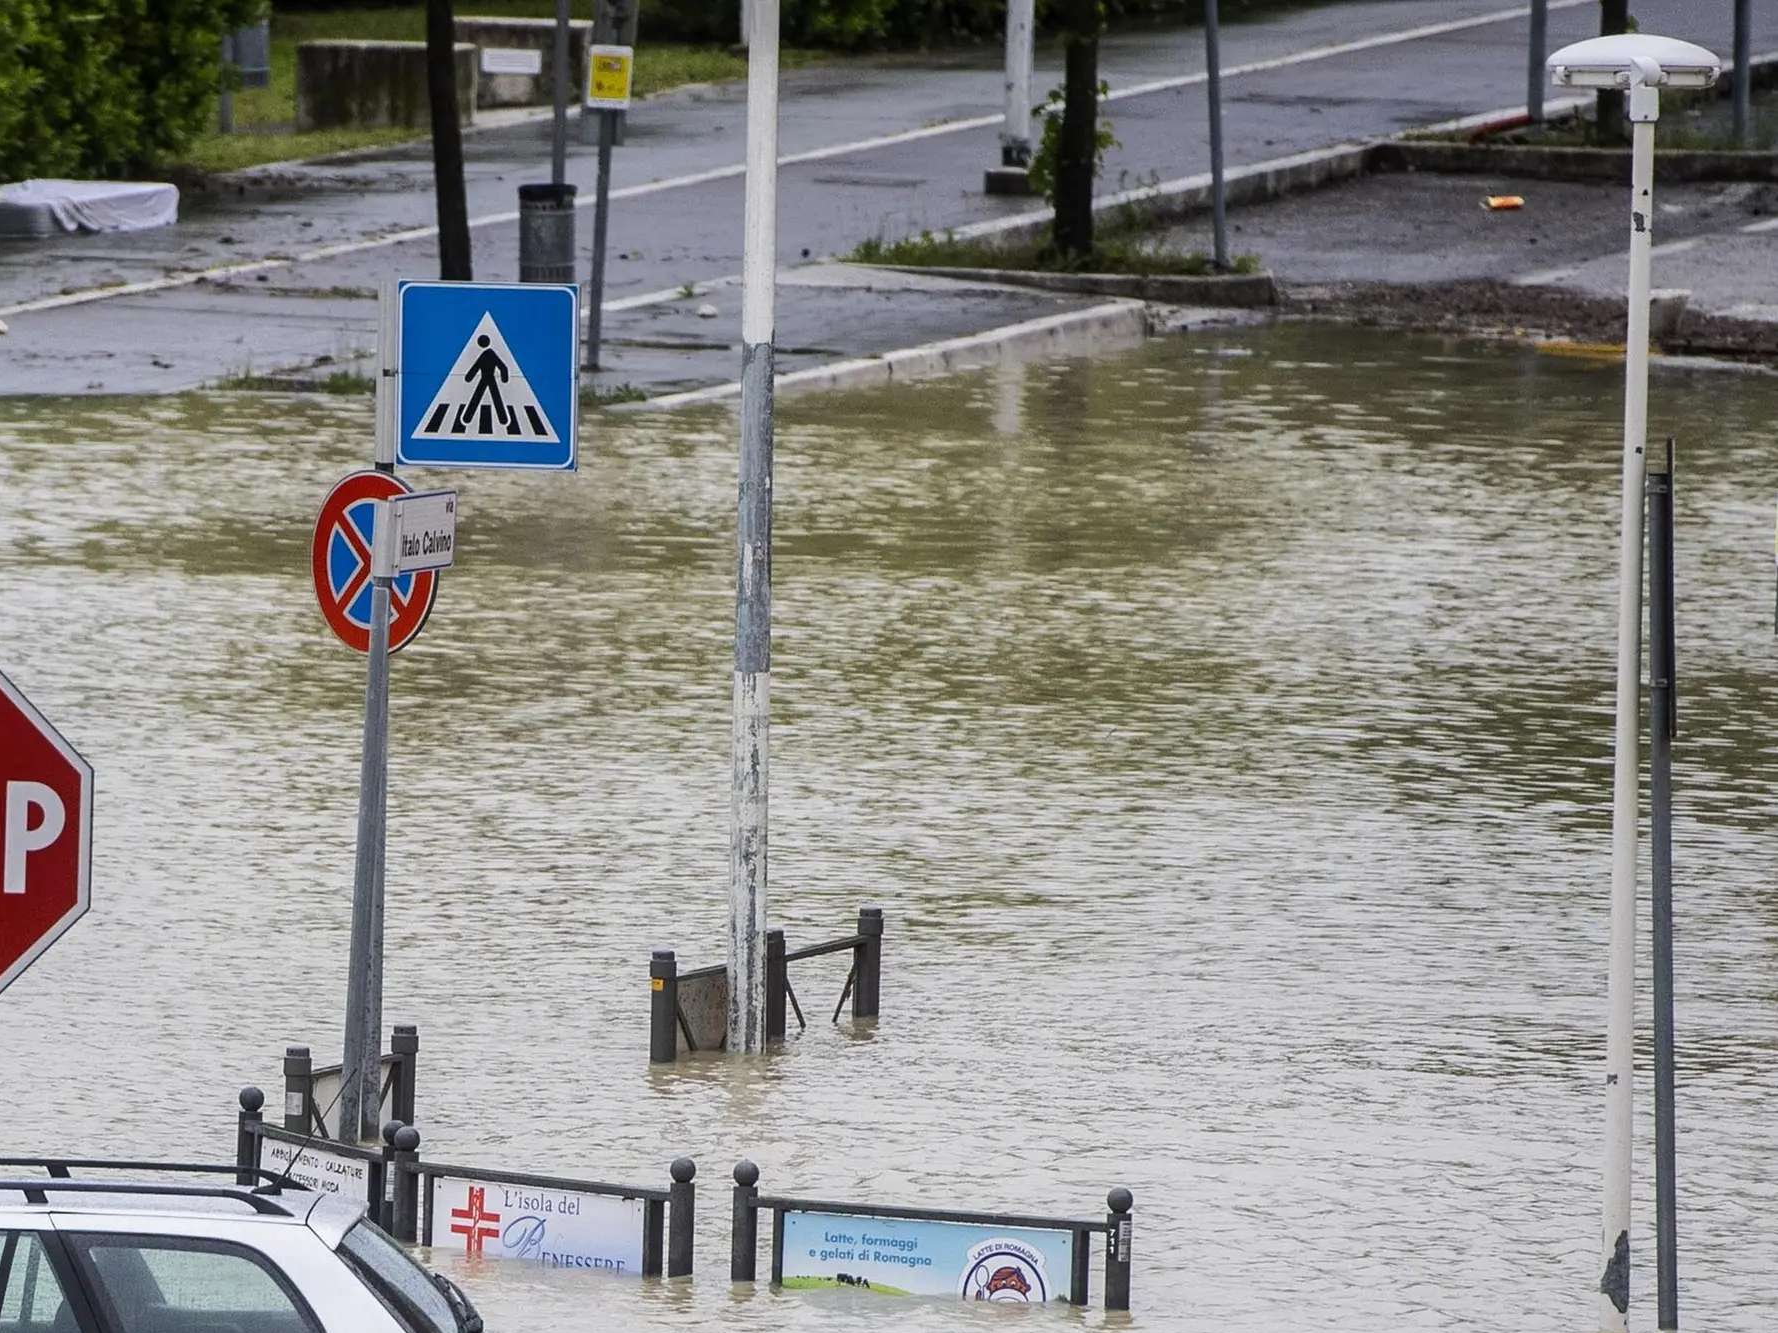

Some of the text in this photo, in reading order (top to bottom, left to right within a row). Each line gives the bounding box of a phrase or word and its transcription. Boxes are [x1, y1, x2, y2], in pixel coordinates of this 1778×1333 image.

[446, 498, 454, 513] via
[402, 529, 452, 557] Italo Calvino
[325, 1161, 363, 1180] CALZATURE
[321, 1180, 339, 1193] MODA
[504, 1190, 580, 1215] L'isola del
[824, 1231, 919, 1252] Latte, formaggi
[808, 1247, 932, 1267] e gelati di Romagna
[972, 1244, 993, 1260] LATTE
[1004, 1243, 1039, 1265] ROMAGNA
